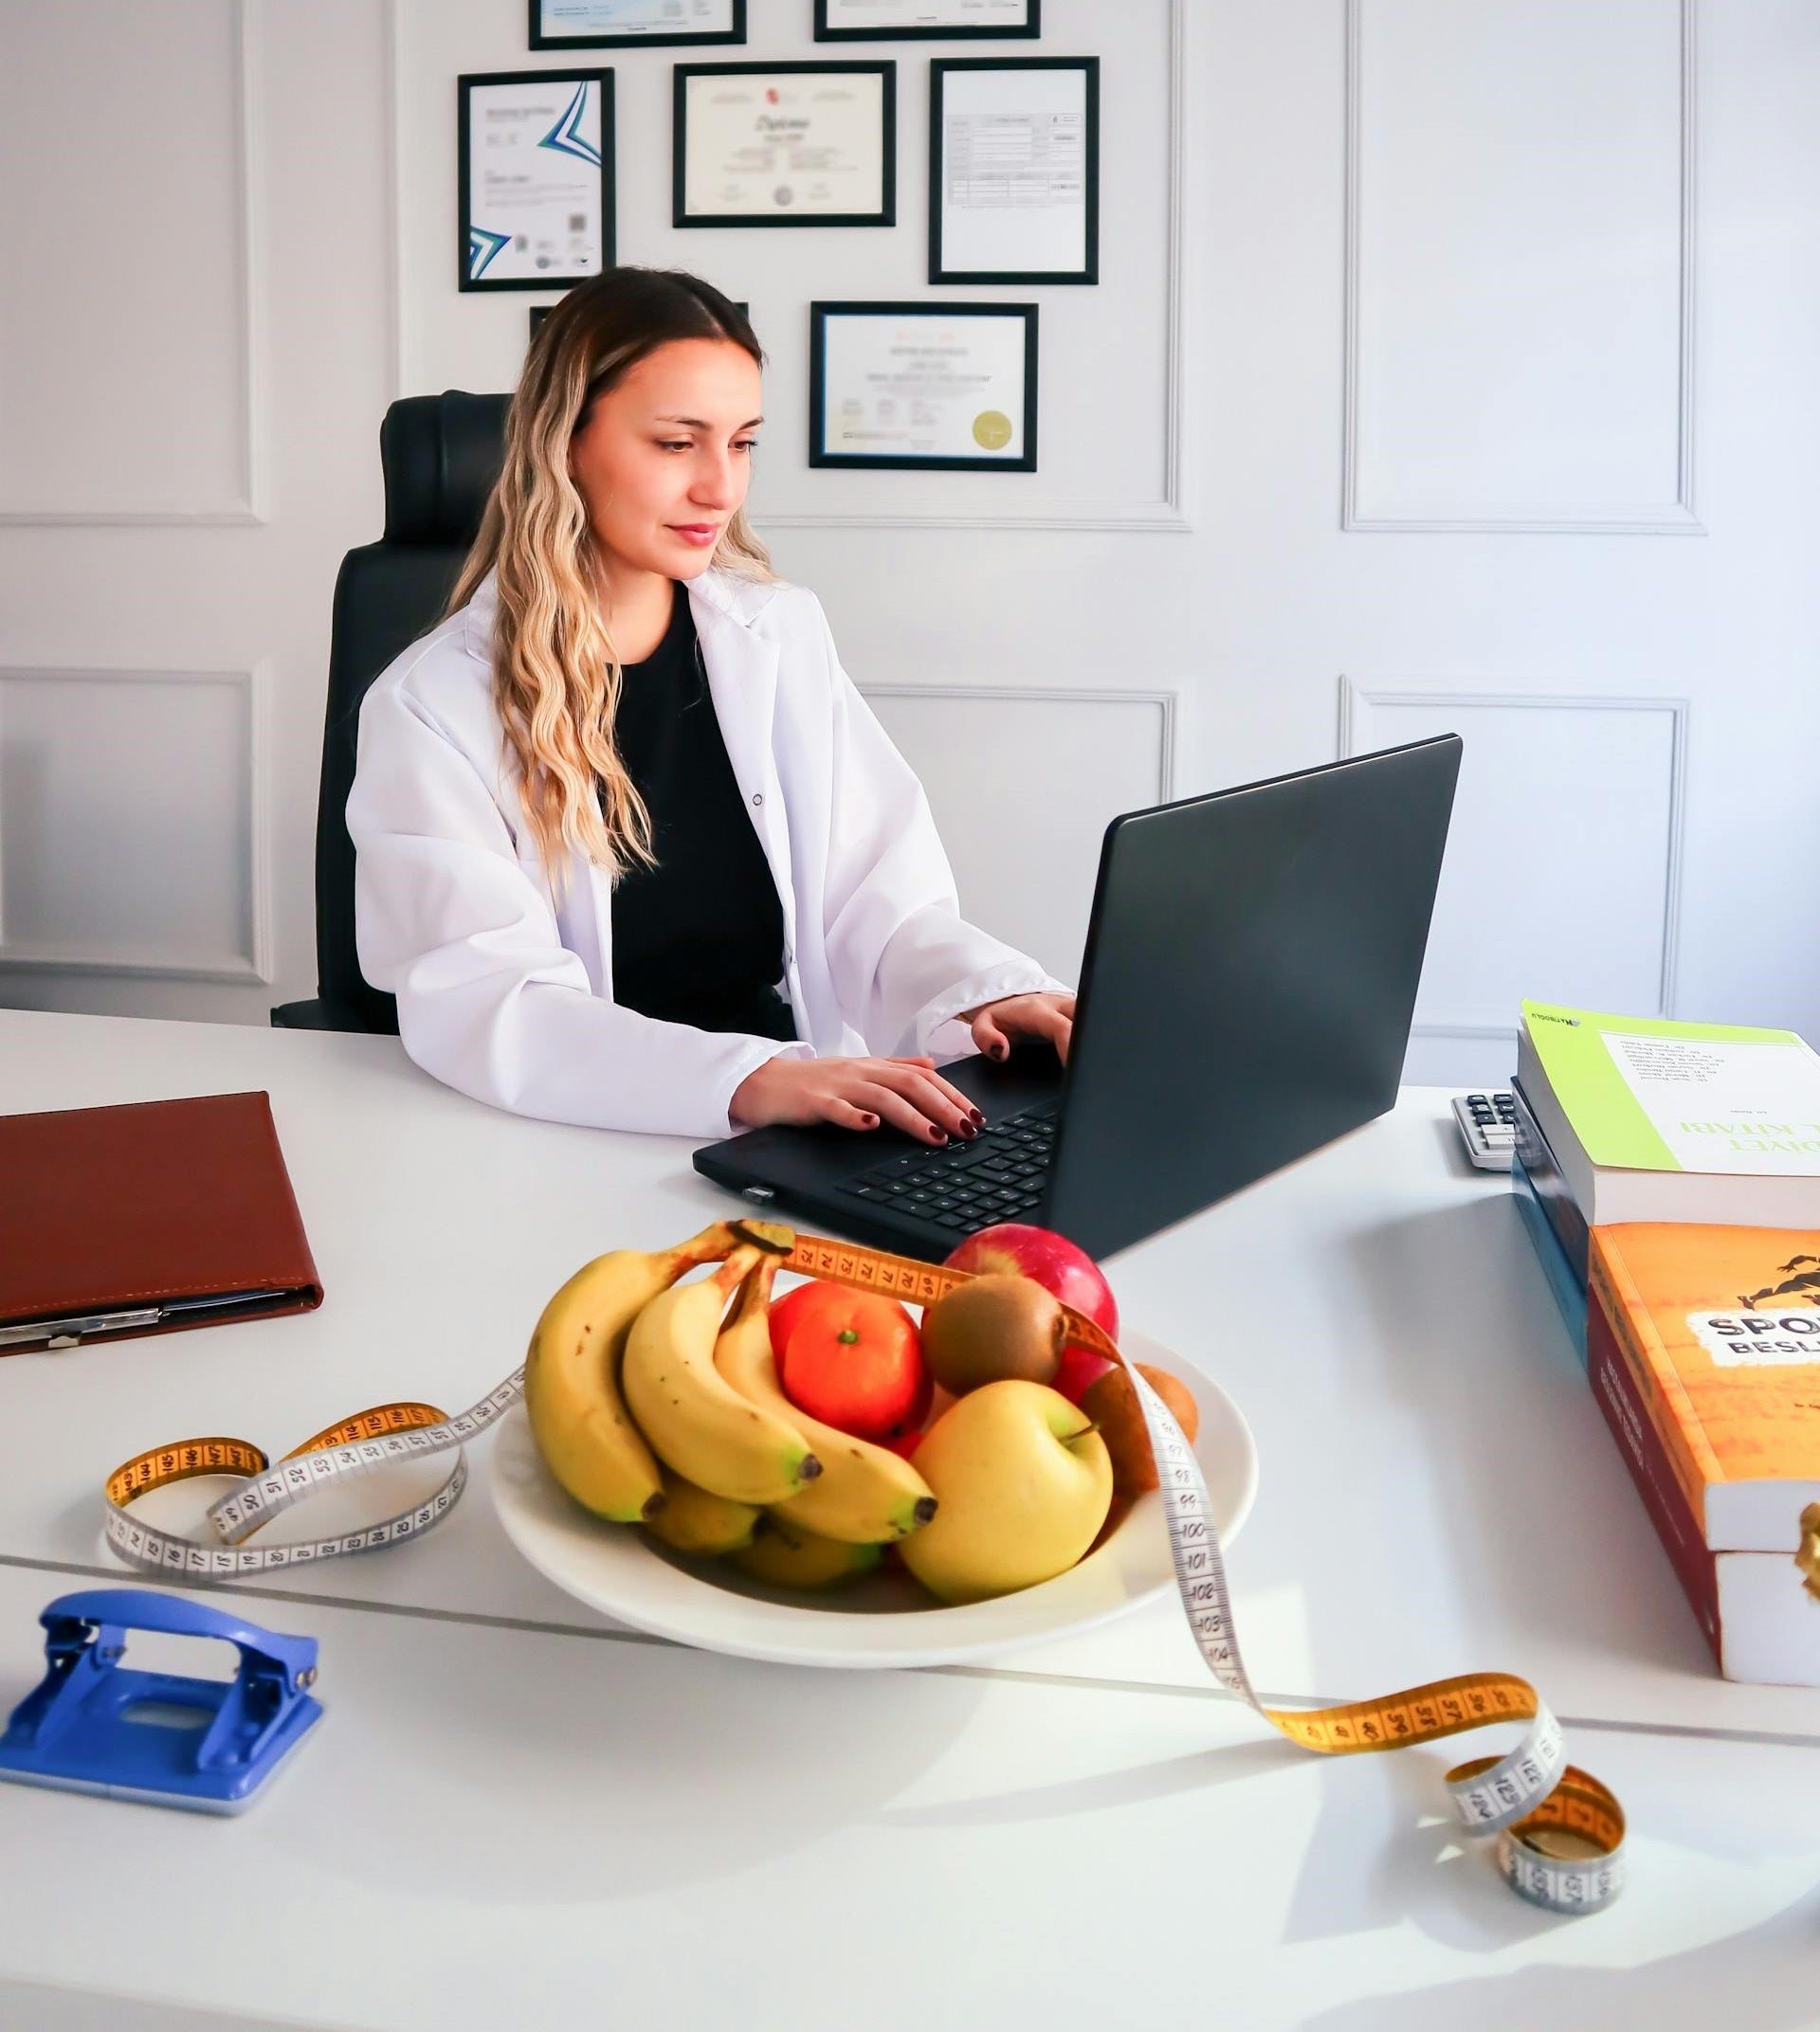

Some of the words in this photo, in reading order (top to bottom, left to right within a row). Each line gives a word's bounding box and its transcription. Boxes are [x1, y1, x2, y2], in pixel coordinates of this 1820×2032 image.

[801, 1249, 813, 1264] 75
[861, 1263, 873, 1279] 72
[882, 1270, 894, 1283] 71
[901, 1273, 914, 1289] 70
[1708, 1317, 1820, 1335] SPO
[1727, 1341, 1820, 1353] BESL
[371, 1415, 382, 1431] 115
[346, 1424, 360, 1441] 114
[408, 1435, 426, 1445] 57
[365, 1445, 379, 1458] 55
[389, 1441, 403, 1451] 56
[1168, 1444, 1183, 1456] 97
[186, 1449, 197, 1466] 146
[209, 1445, 221, 1464] 147
[338, 1451, 356, 1463] 54
[162, 1454, 173, 1472] 145
[314, 1458, 331, 1473] 53
[140, 1463, 151, 1480] 144
[288, 1468, 306, 1483] 52
[1174, 1469, 1191, 1483] 98
[123, 1472, 133, 1491] 143
[265, 1481, 282, 1494] 51
[243, 1494, 260, 1510] 50
[1179, 1494, 1196, 1509] 99
[226, 1508, 238, 1521] 49
[418, 1510, 430, 1522] 26
[396, 1520, 410, 1533] 25
[1183, 1523, 1206, 1538] 100
[347, 1538, 361, 1549] 23
[372, 1532, 385, 1543] 24
[147, 1541, 159, 1555] 15
[321, 1545, 335, 1553] 22
[168, 1549, 181, 1563] 16
[191, 1552, 206, 1567] 17
[217, 1554, 231, 1567] 18
[243, 1555, 257, 1566] 19
[270, 1551, 283, 1562] 20
[1188, 1552, 1206, 1569] 101
[1192, 1583, 1214, 1601] 102
[1200, 1616, 1221, 1633] 103
[1209, 1647, 1228, 1662] 104
[1443, 1698, 1463, 1722] 37
[1521, 1760, 1542, 1784] 122
